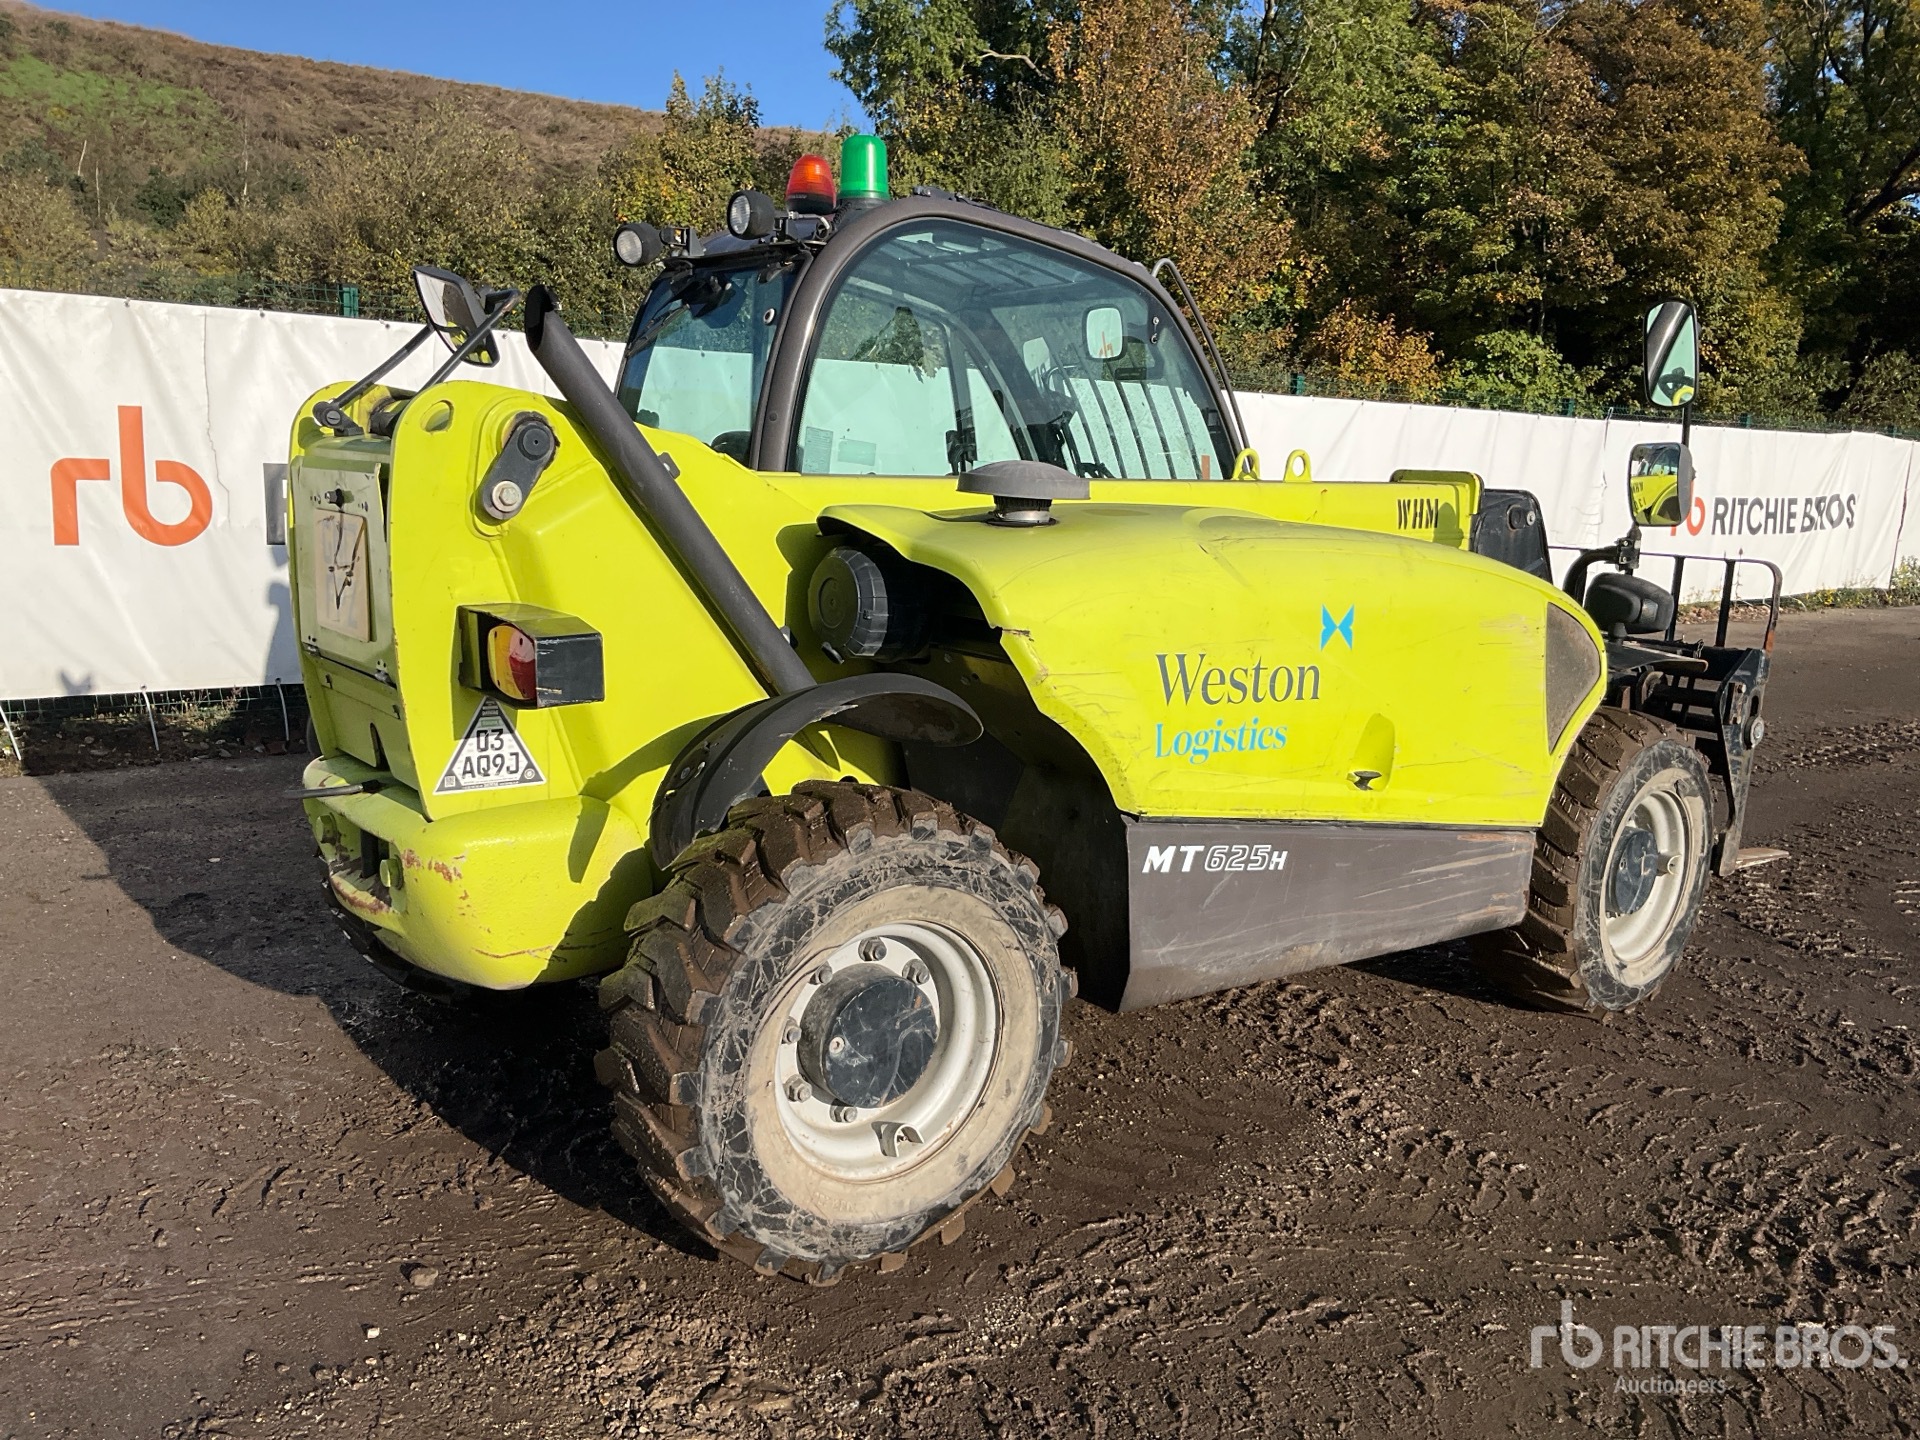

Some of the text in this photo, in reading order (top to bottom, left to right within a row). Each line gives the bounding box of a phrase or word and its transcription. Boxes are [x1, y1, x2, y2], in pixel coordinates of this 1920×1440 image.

[50, 405, 213, 546] rb
[1397, 498, 1439, 530] WHM
[1711, 497, 1798, 536] RITCHIE
[1800, 493, 1856, 533] BROS
[1155, 653, 1320, 706] Weston
[1155, 717, 1288, 765] Logistics
[461, 752, 520, 779] AQ9J
[1141, 845, 1205, 873] MT
